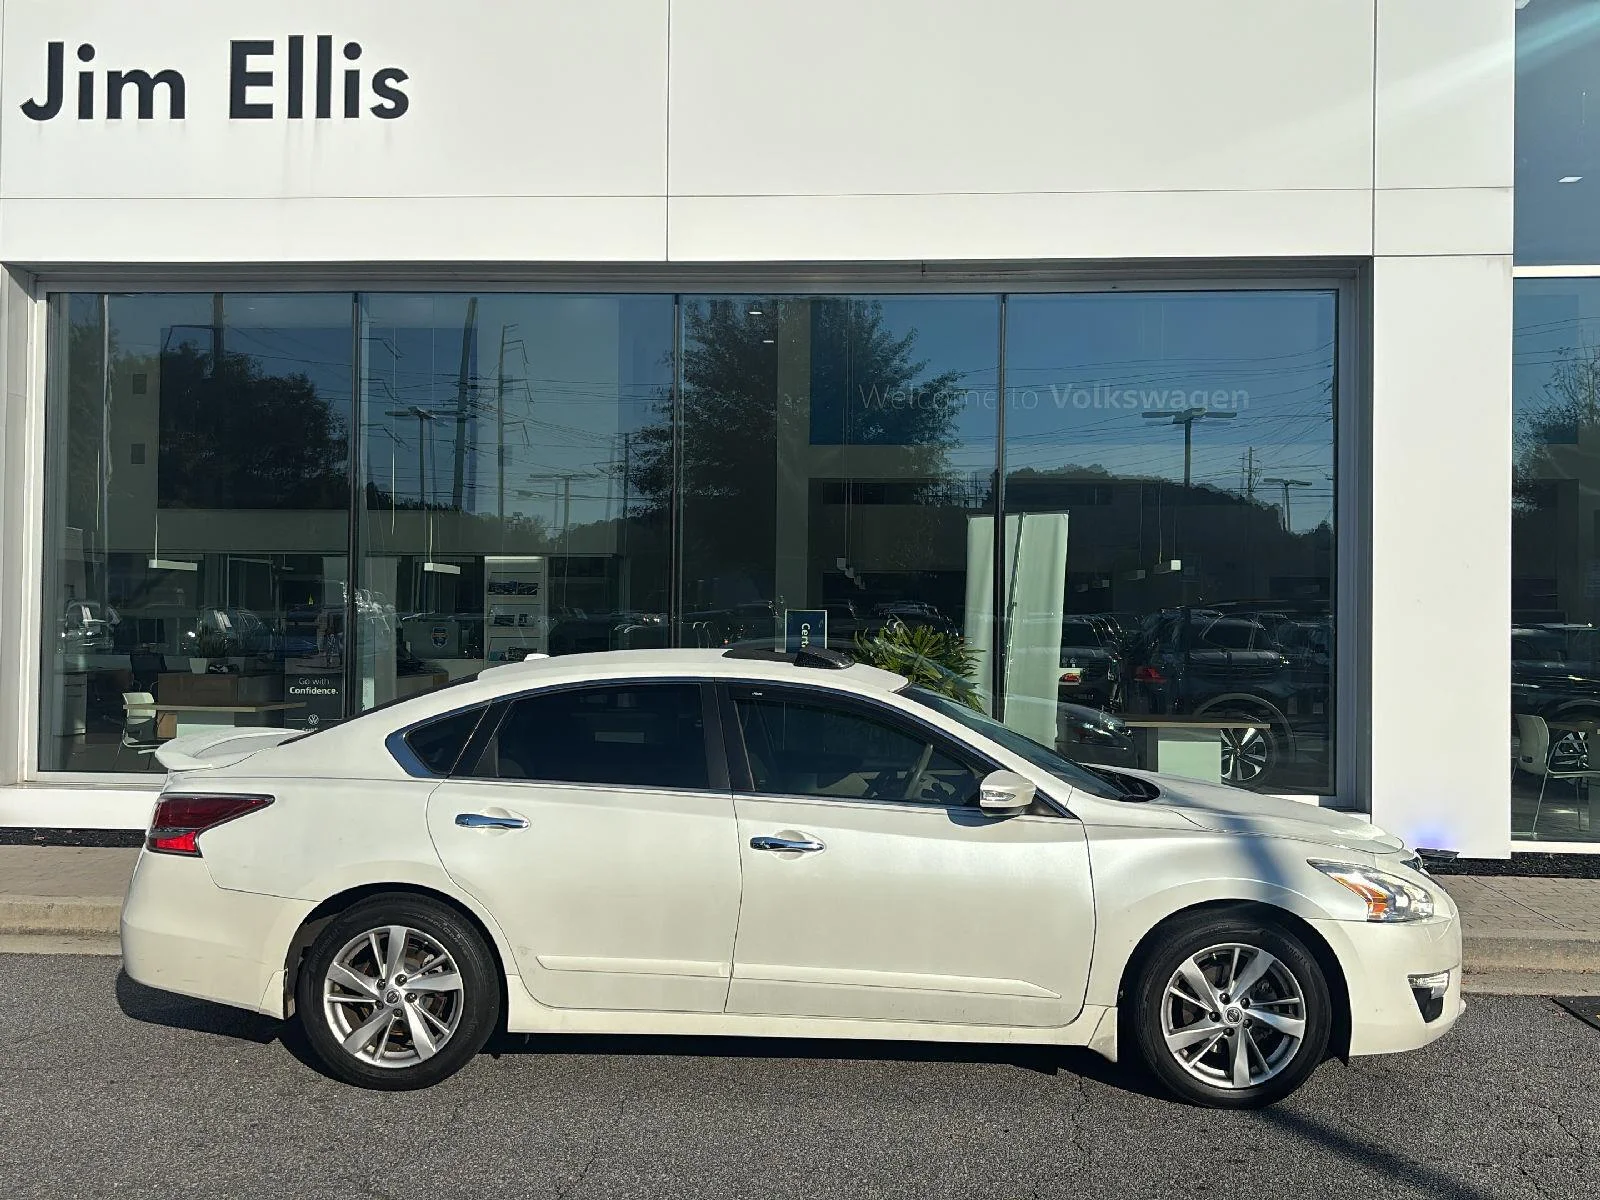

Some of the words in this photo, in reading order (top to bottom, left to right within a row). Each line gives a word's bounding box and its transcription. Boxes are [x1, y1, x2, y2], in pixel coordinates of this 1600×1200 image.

[20, 41, 186, 121] Jim
[229, 34, 409, 119] Ellis
[858, 383, 997, 410] Welcome
[1010, 385, 1040, 410] to
[1050, 383, 1250, 412] Volkswagen
[289, 686, 339, 695] Confidence.
[298, 677, 310, 685] Go
[312, 677, 330, 686] with
